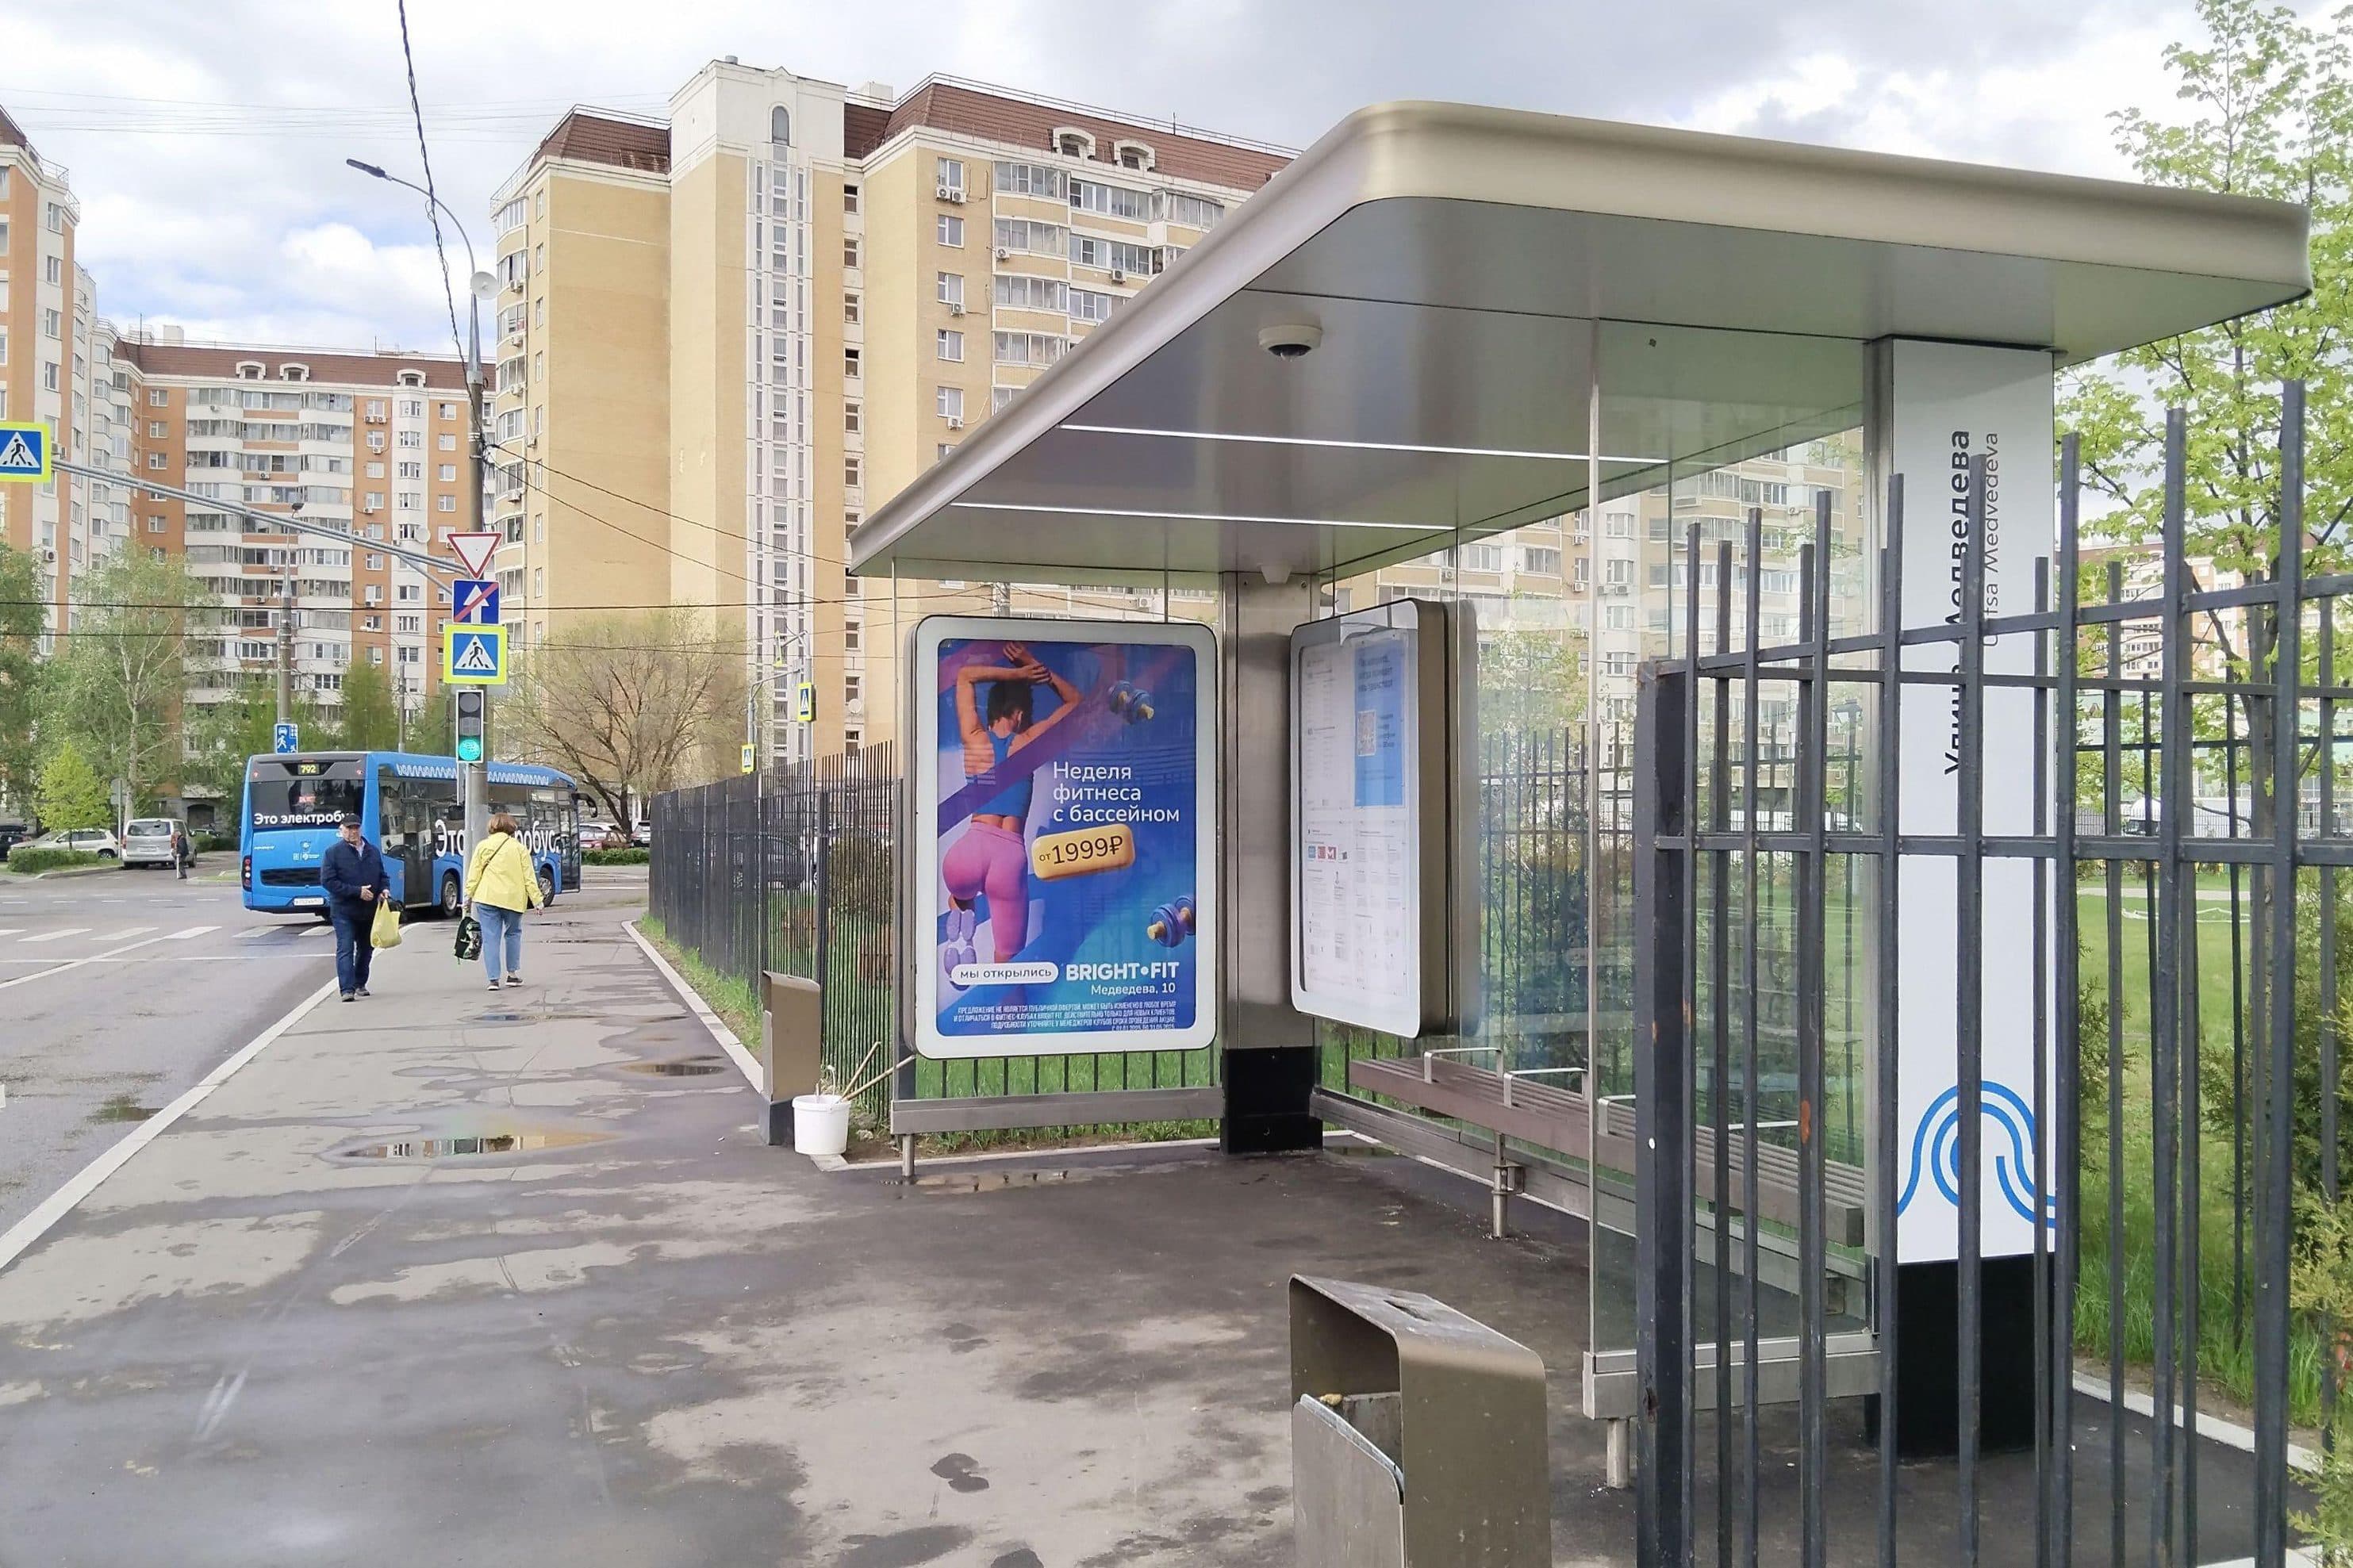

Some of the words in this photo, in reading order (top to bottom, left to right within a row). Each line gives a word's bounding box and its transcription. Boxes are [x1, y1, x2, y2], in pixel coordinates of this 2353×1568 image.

[301, 765, 317, 774] 792
[1054, 761, 1131, 782] Неделя
[1054, 784, 1141, 803] фитнеса
[254, 813, 278, 826] Это
[281, 810, 355, 826] электроб
[1053, 809, 1064, 822] с
[1070, 804, 1180, 822] бассейном
[1039, 853, 1051, 862] от
[960, 970, 979, 979] мы
[984, 968, 1052, 980] открылись
[1162, 983, 1176, 994] 10
